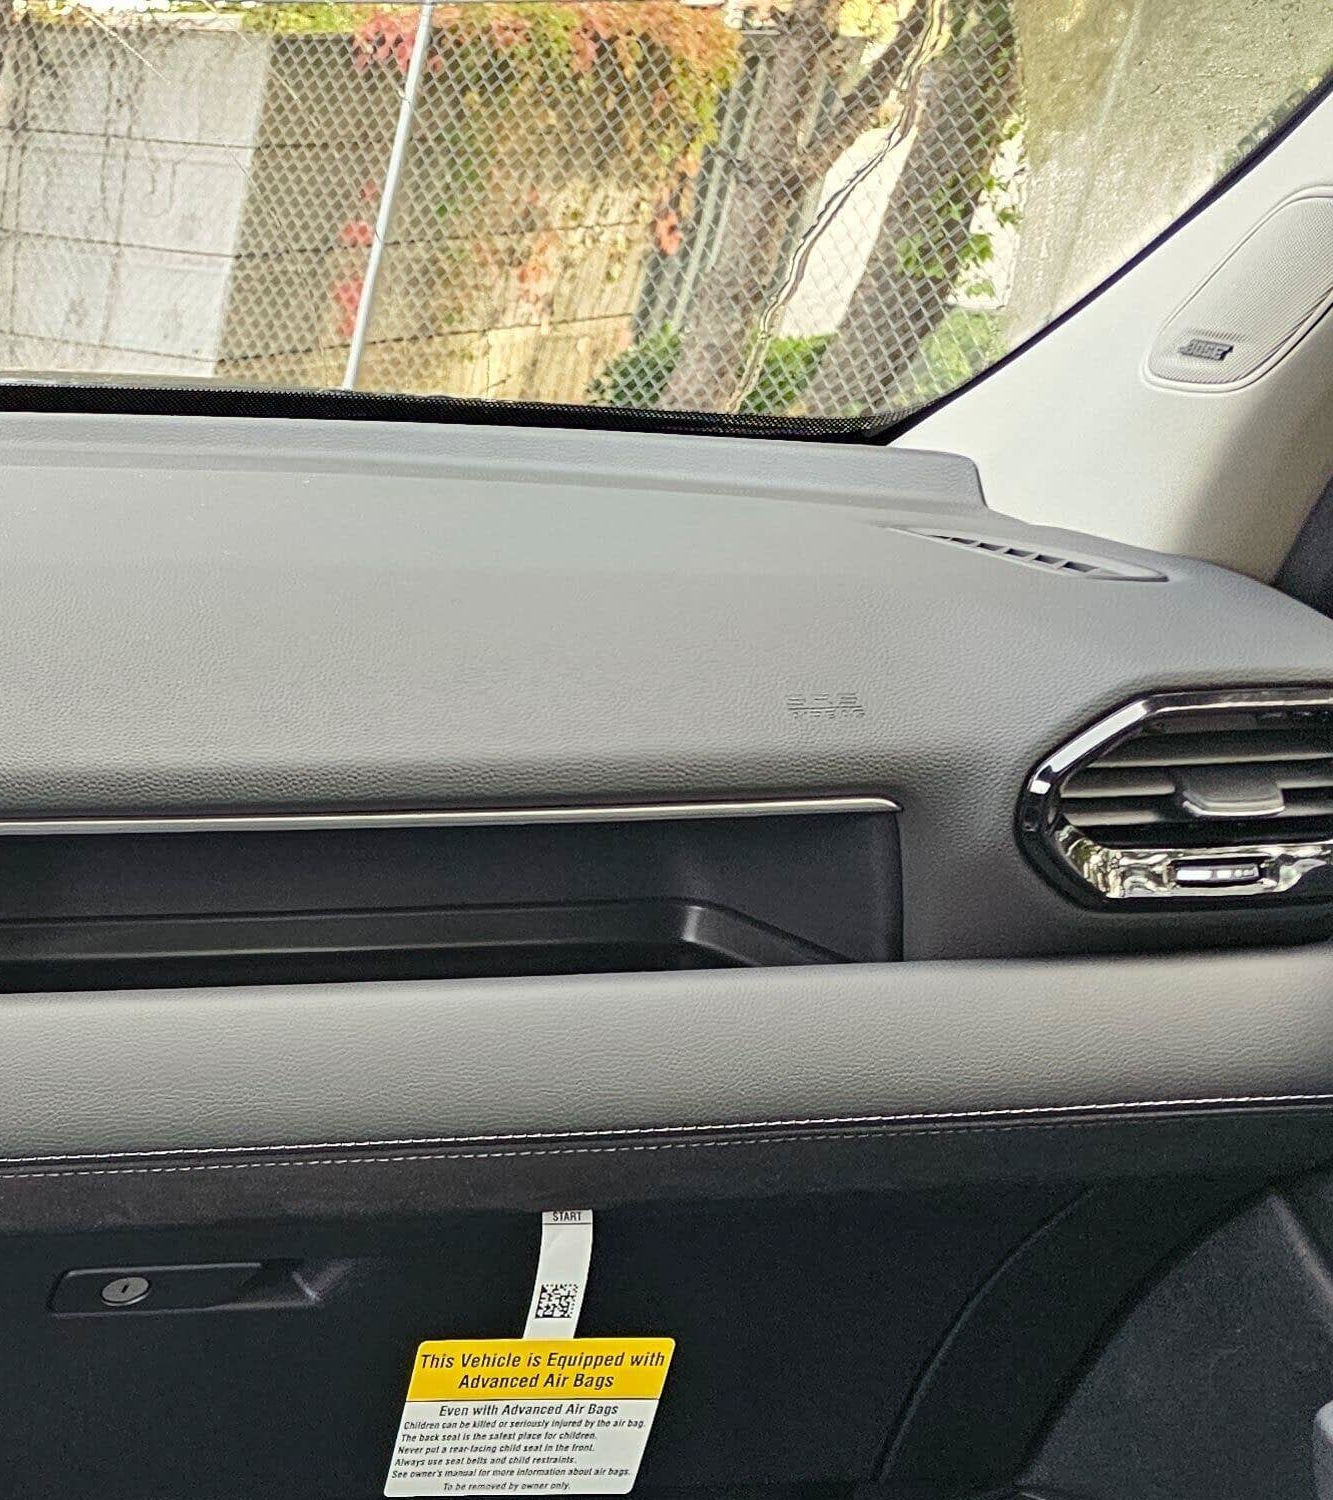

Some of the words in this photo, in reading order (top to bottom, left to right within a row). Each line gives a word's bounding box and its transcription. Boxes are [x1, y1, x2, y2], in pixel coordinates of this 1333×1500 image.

[552, 1210, 582, 1222] START
[421, 1354, 455, 1369] This
[461, 1353, 521, 1368] Vehicle
[526, 1353, 542, 1367] is
[547, 1352, 625, 1370] Equipped
[630, 1352, 665, 1366] with
[458, 1374, 540, 1389] Advanced
[543, 1373, 569, 1387] Air
[573, 1373, 614, 1390] Bags
[439, 1405, 469, 1416] Even
[473, 1405, 498, 1416] with
[501, 1404, 563, 1416] Advanced
[565, 1404, 585, 1415] Air
[588, 1403, 619, 1416] Bags
[404, 1421, 440, 1430] Children
[459, 1421, 471, 1429] be
[472, 1420, 497, 1428] killed
[509, 1420, 549, 1429] seriously
[551, 1419, 583, 1429] injured
[584, 1419, 595, 1429] by
[597, 1419, 611, 1427] the
[612, 1419, 626, 1427] air
[627, 1419, 646, 1429] bag.
[402, 1433, 417, 1442] The
[419, 1433, 439, 1442] back
[442, 1433, 461, 1441] seat
[489, 1432, 516, 1440] safest
[518, 1432, 542, 1440] place
[544, 1432, 557, 1440] for
[559, 1432, 598, 1440] children.
[398, 1446, 423, 1455] Never
[425, 1446, 440, 1455] put
[449, 1445, 497, 1453] rear-facing
[499, 1444, 521, 1452] child
[523, 1444, 543, 1452] seat
[544, 1444, 553, 1452] in
[572, 1443, 595, 1451] front.
[394, 1458, 425, 1467] Always
[466, 1457, 487, 1465] belts
[508, 1456, 531, 1464] child
[532, 1456, 577, 1464] restraints.
[391, 1470, 408, 1479] See
[409, 1470, 443, 1478] owner's
[444, 1469, 477, 1477] manual
[478, 1469, 491, 1477] for
[516, 1468, 566, 1476] information
[567, 1468, 592, 1476] about
[608, 1468, 631, 1477] bags.
[443, 1483, 453, 1491] To
[455, 1483, 466, 1491] be
[468, 1482, 507, 1490] removed
[508, 1482, 519, 1491] by
[550, 1481, 571, 1490] only.
